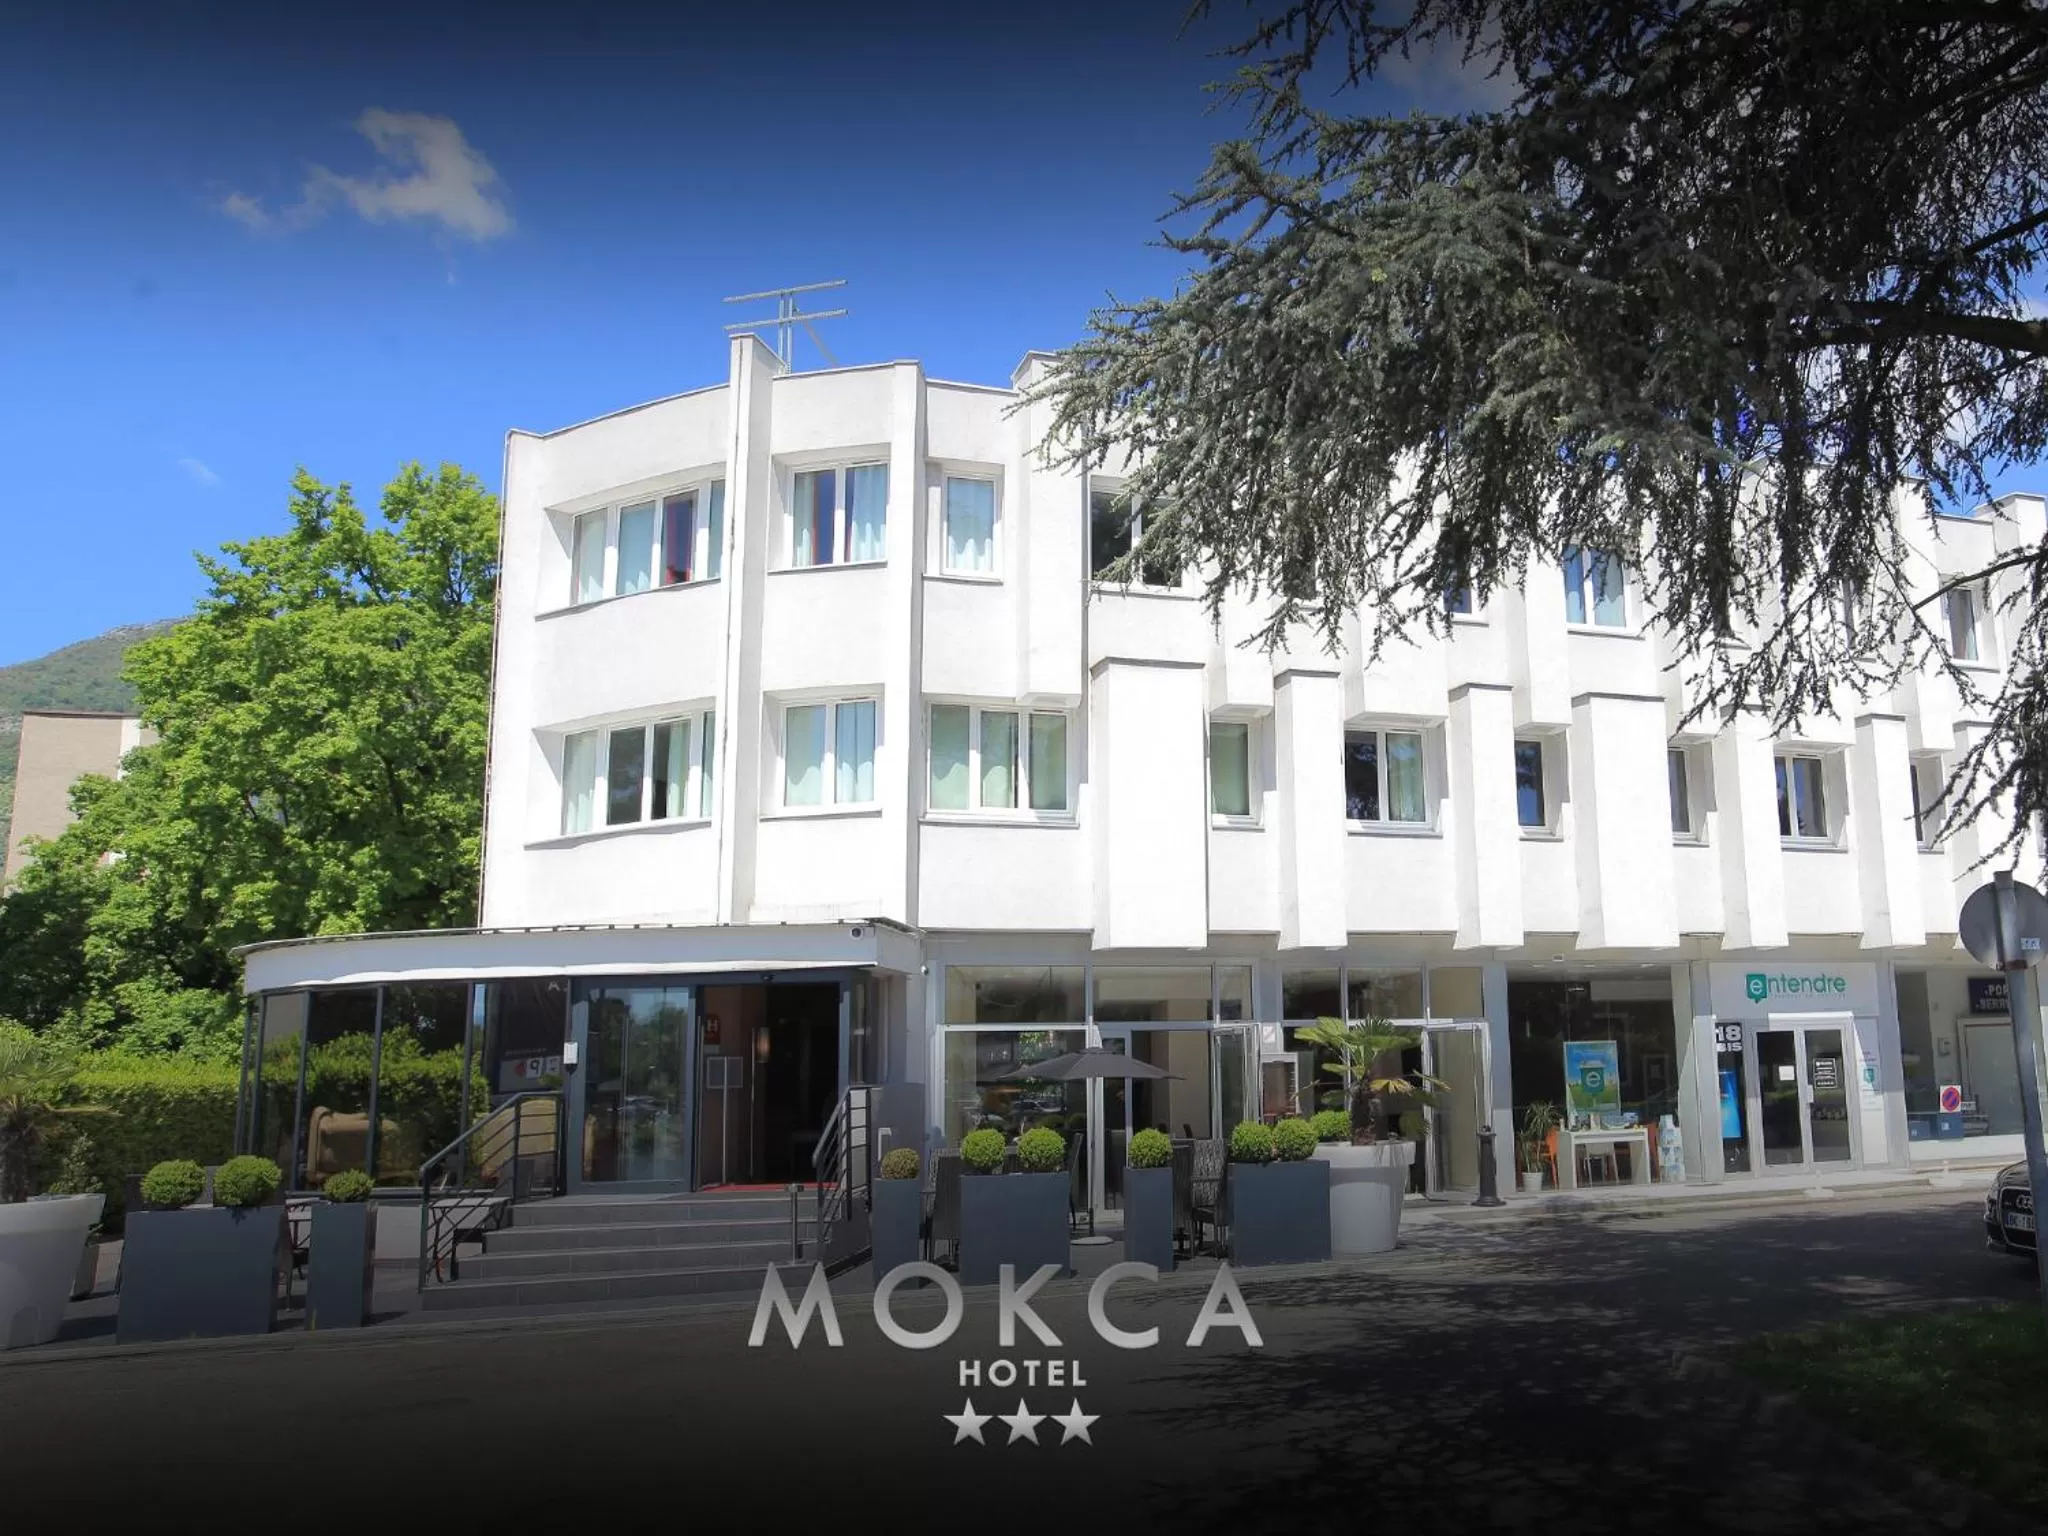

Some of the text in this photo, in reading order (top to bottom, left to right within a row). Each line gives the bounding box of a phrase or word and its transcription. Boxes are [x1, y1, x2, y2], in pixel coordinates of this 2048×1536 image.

[1746, 973, 1846, 996] entendre
[1715, 1025, 1741, 1041] 18
[1716, 1042, 1742, 1052] BIS
